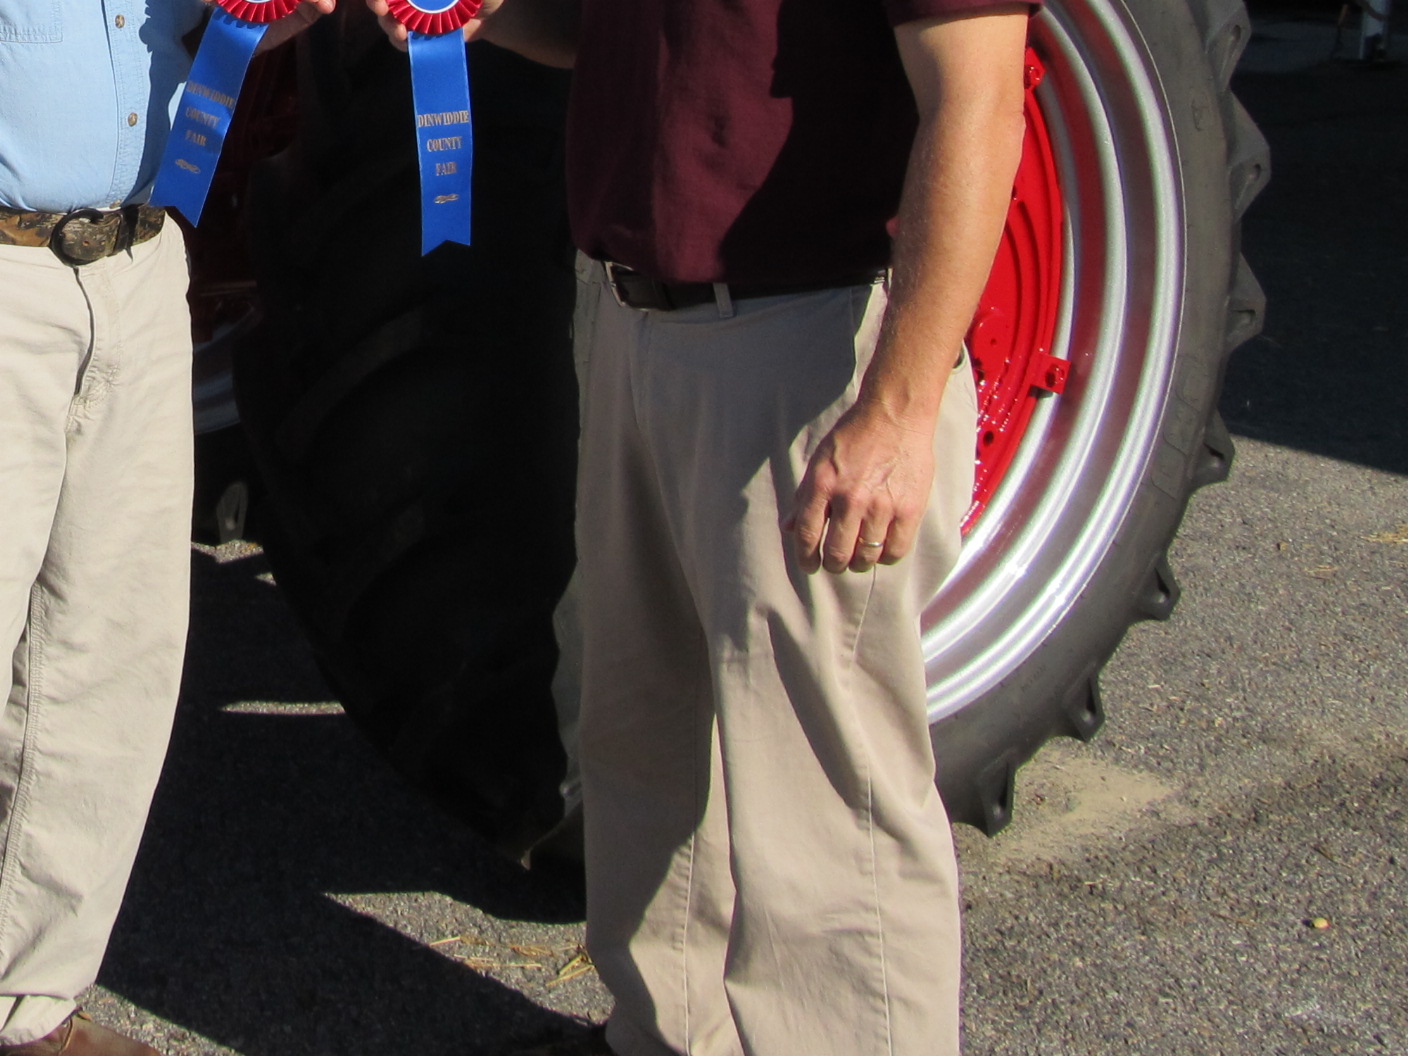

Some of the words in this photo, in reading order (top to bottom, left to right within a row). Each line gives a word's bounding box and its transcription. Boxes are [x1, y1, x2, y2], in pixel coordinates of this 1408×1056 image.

[186, 106, 221, 129] COUNTY
[417, 110, 469, 128] DINWIDDIE
[186, 130, 207, 146] FAIR
[426, 136, 462, 152] COUNTY
[435, 161, 458, 177] FAIR
